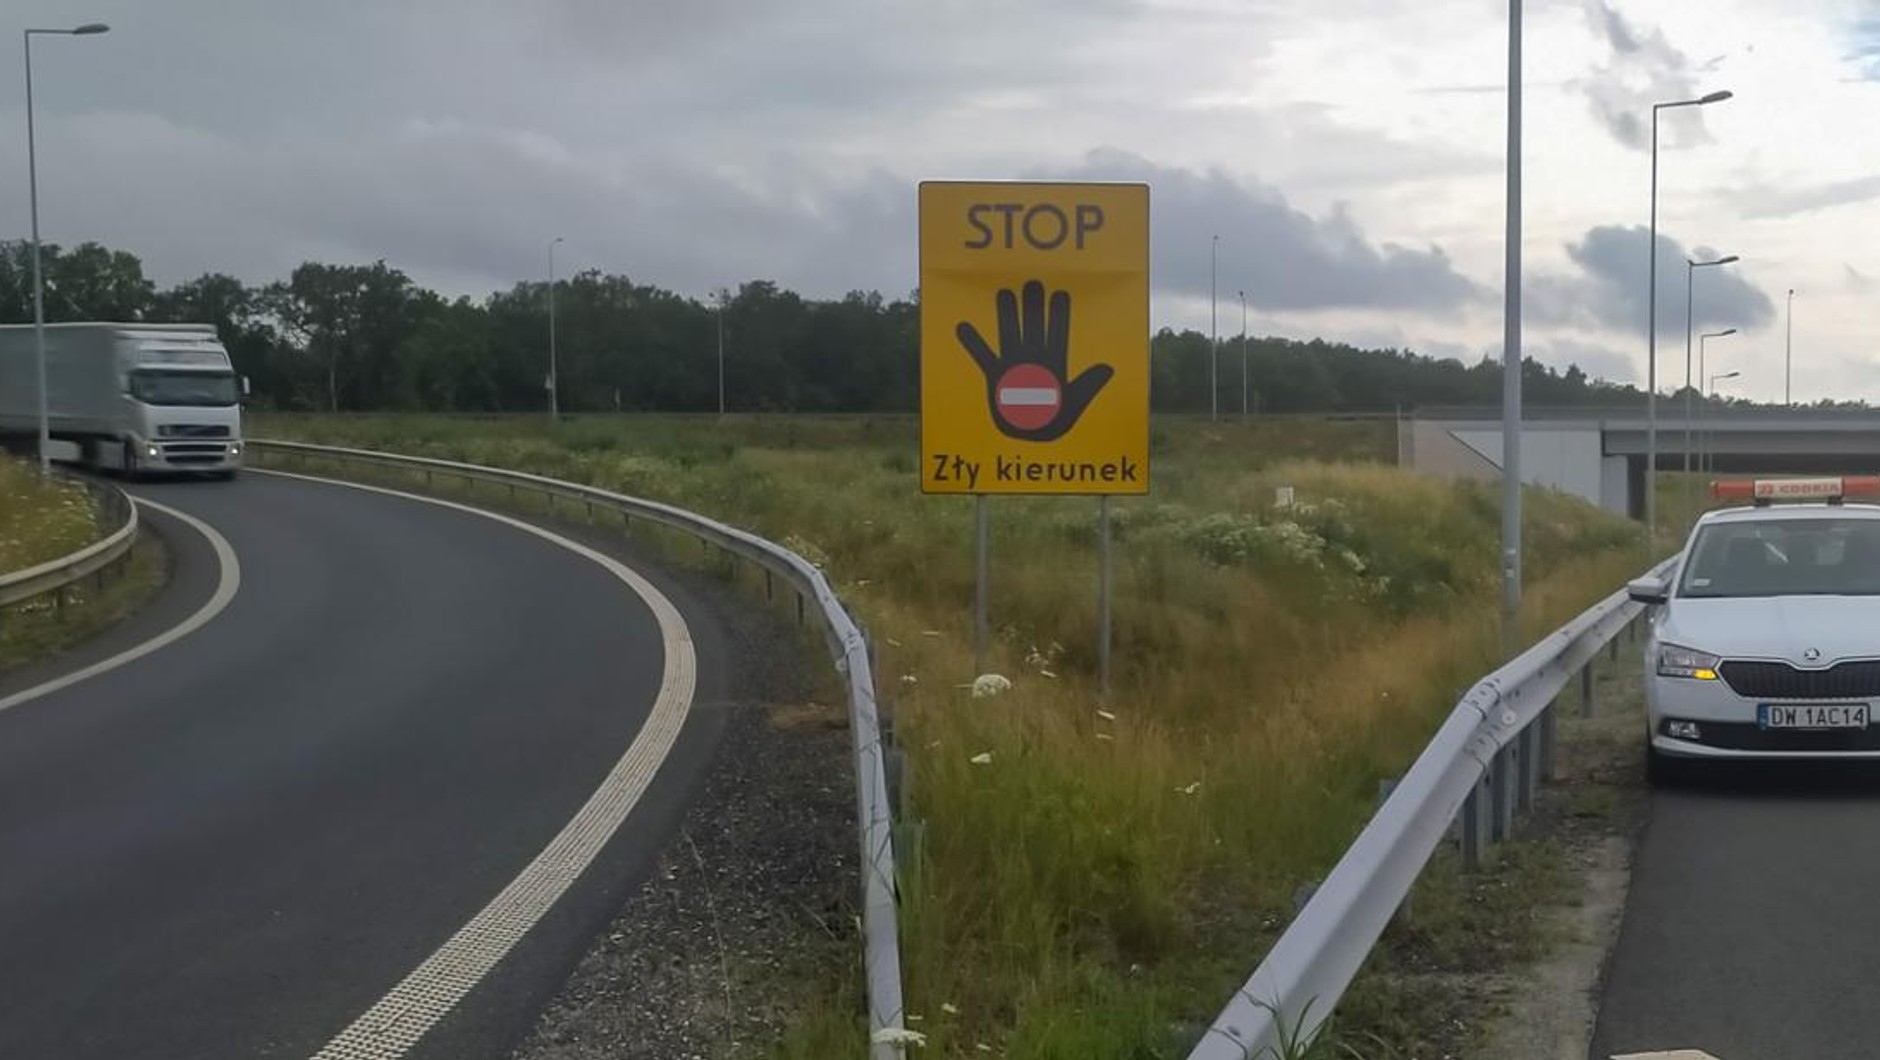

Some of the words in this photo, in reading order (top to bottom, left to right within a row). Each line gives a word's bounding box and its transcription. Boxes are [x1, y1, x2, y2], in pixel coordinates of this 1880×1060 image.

[964, 203, 1105, 250] STOP
[932, 454, 980, 489] Zły
[997, 455, 1137, 482] kierunek
[1771, 707, 1797, 725] DW
[1806, 707, 1864, 725] 1AC14
